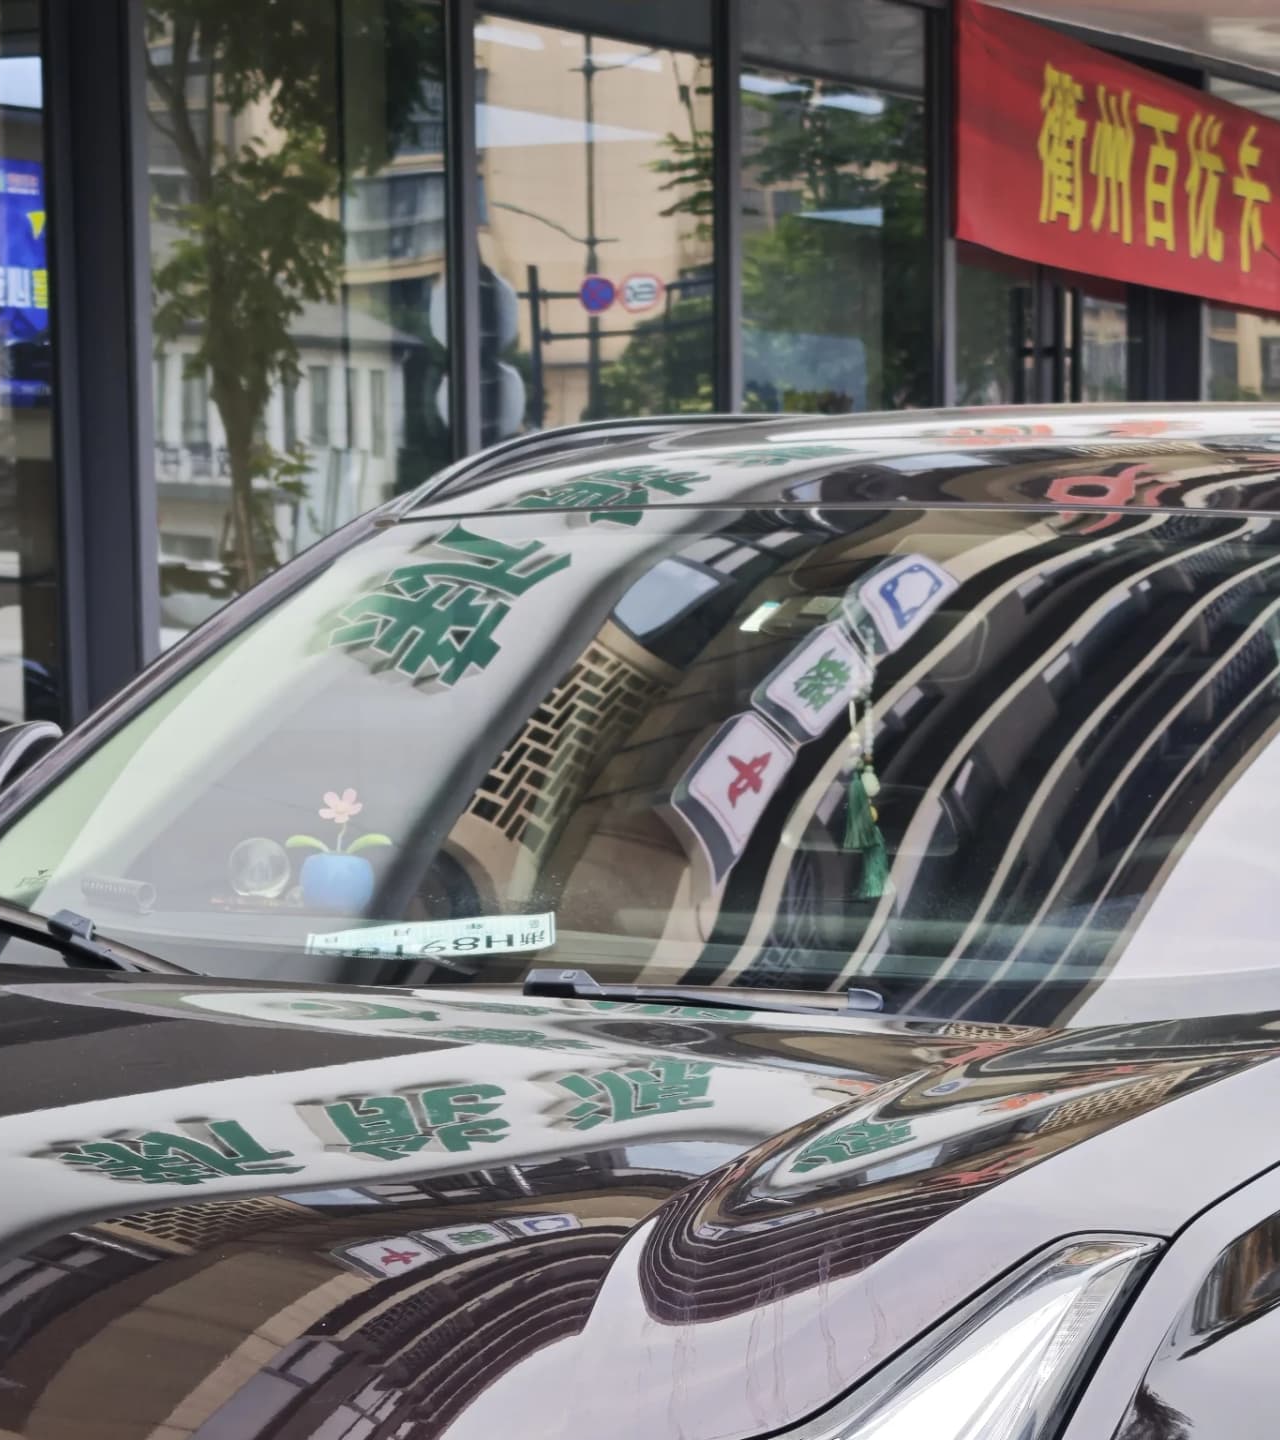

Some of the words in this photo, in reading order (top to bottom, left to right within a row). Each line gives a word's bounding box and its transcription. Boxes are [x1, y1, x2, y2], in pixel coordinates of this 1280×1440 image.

[1037, 62, 1272, 273] 衢州百优卡
